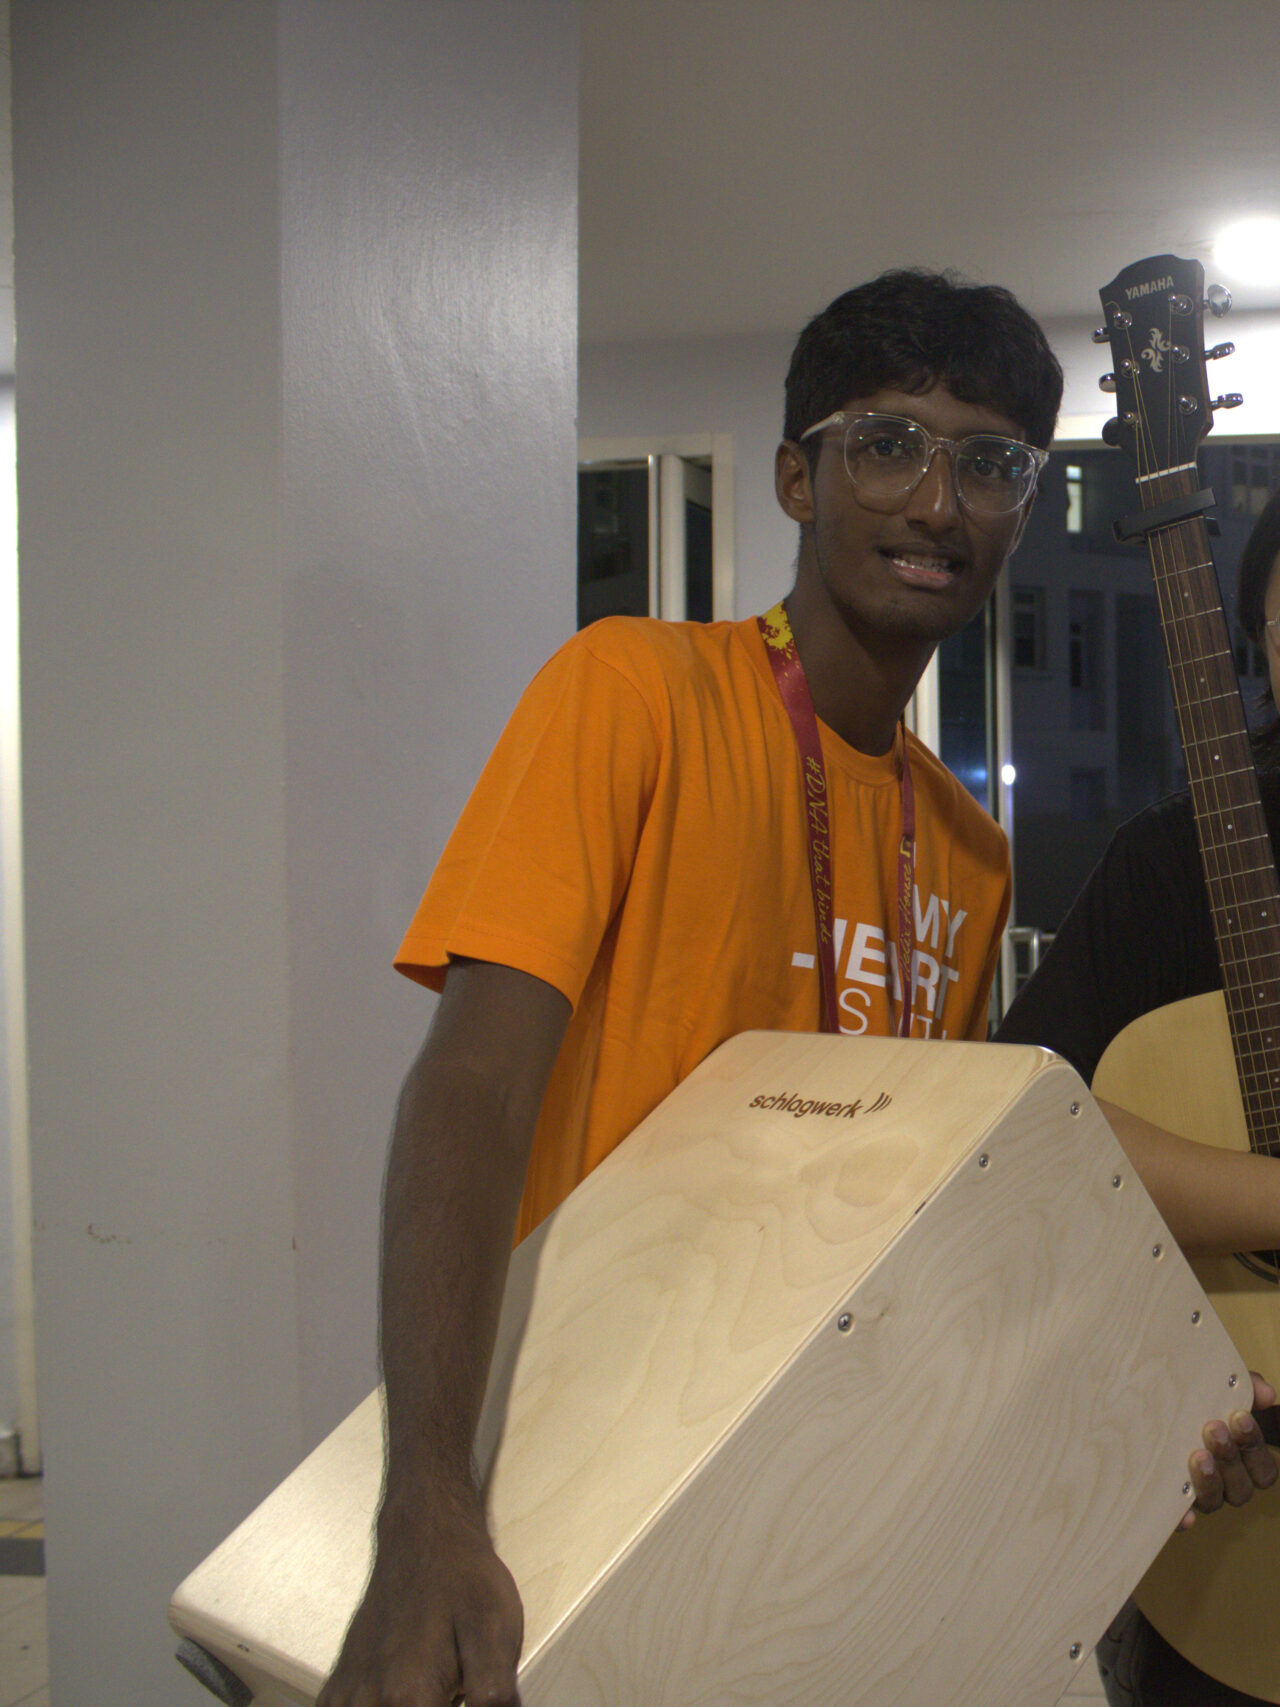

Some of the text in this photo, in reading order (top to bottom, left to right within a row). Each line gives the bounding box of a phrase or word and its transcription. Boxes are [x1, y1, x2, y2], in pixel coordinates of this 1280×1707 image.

[1125, 275, 1174, 301] YAMAHA
[805, 756, 832, 945] #DNA that binds
[912, 883, 969, 960] MY
[749, 1092, 864, 1118] schlagwerk
